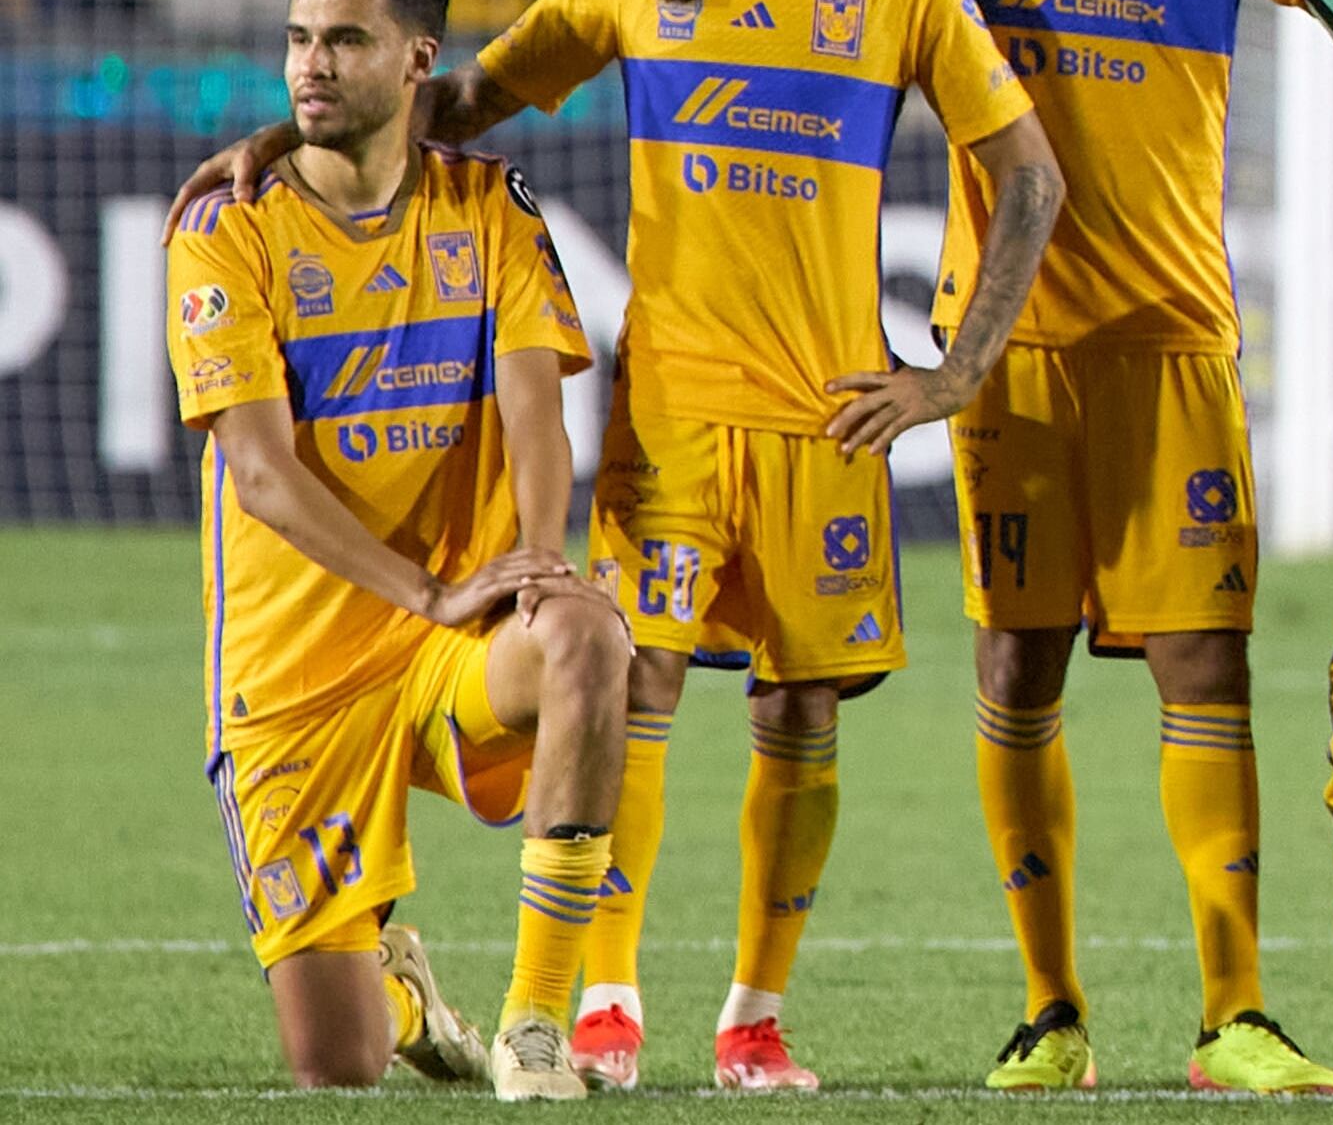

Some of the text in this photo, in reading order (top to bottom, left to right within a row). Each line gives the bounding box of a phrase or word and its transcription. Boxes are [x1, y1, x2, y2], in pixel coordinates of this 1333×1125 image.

[1057, 46, 1146, 84] Bitso
[726, 105, 842, 141] CEMEX
[727, 162, 818, 202] Bitso
[376, 359, 476, 392] CEMEX
[976, 512, 1028, 590] 19
[638, 538, 701, 623] 20
[298, 810, 362, 896] 13
